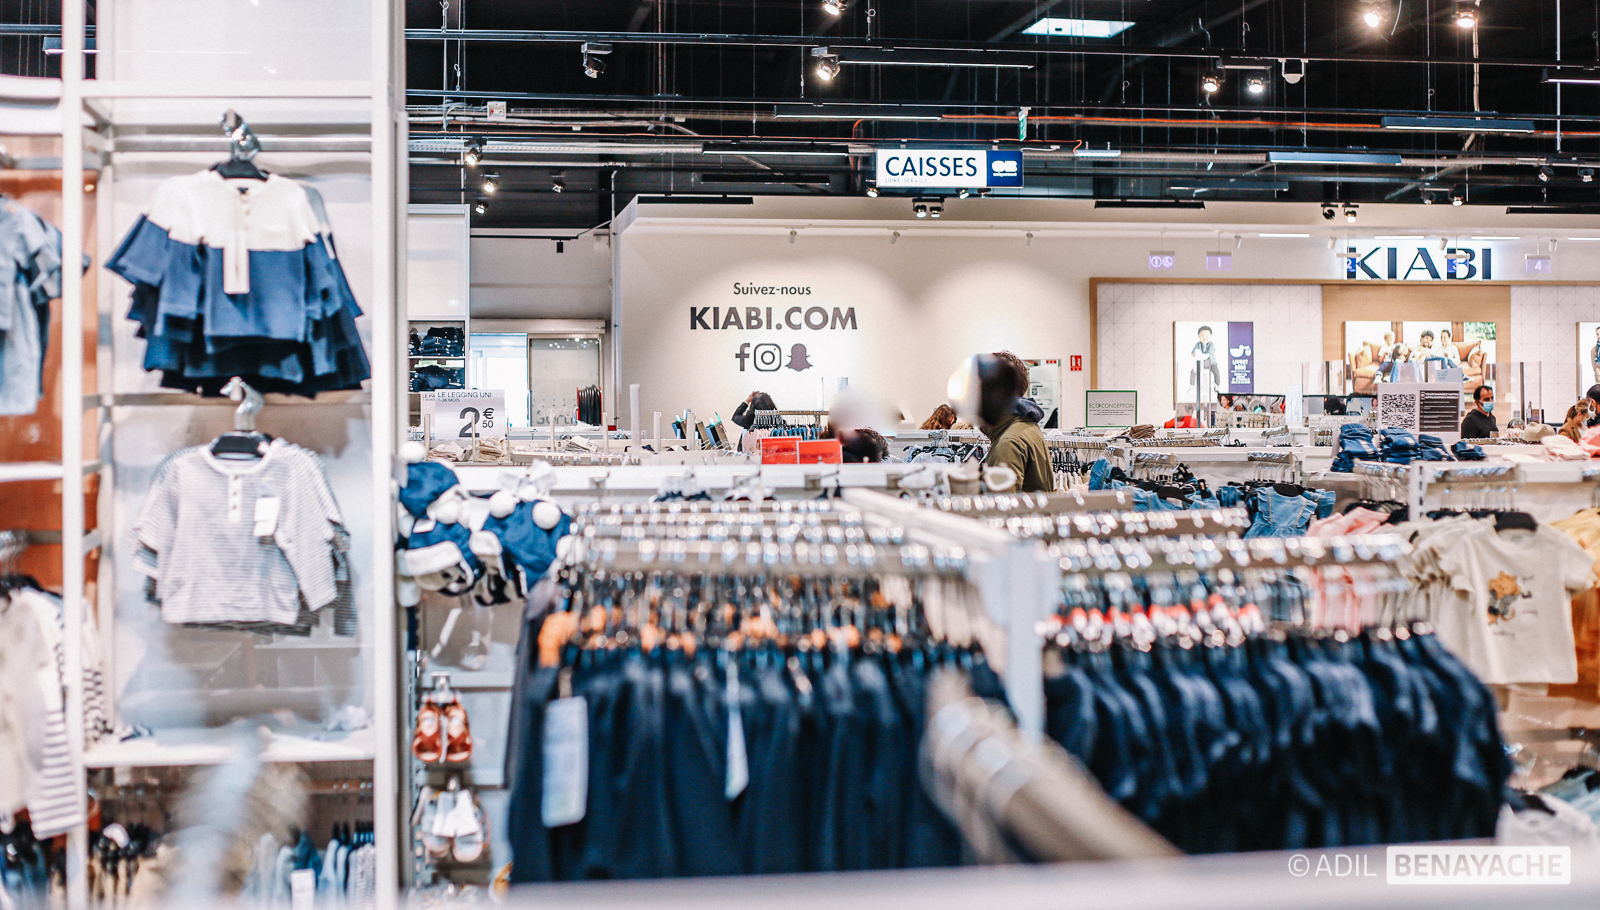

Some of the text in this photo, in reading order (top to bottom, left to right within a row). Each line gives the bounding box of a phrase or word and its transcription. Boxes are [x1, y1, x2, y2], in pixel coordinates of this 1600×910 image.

[885, 156, 977, 177] CAISSES
[1216, 257, 1222, 268] 1
[1346, 247, 1492, 280] KIABI
[1534, 260, 1542, 271] 4
[733, 282, 811, 295] Suivez-nous
[690, 306, 858, 330] KIABI.COM
[458, 407, 480, 438] 2
[482, 420, 494, 428] 50
